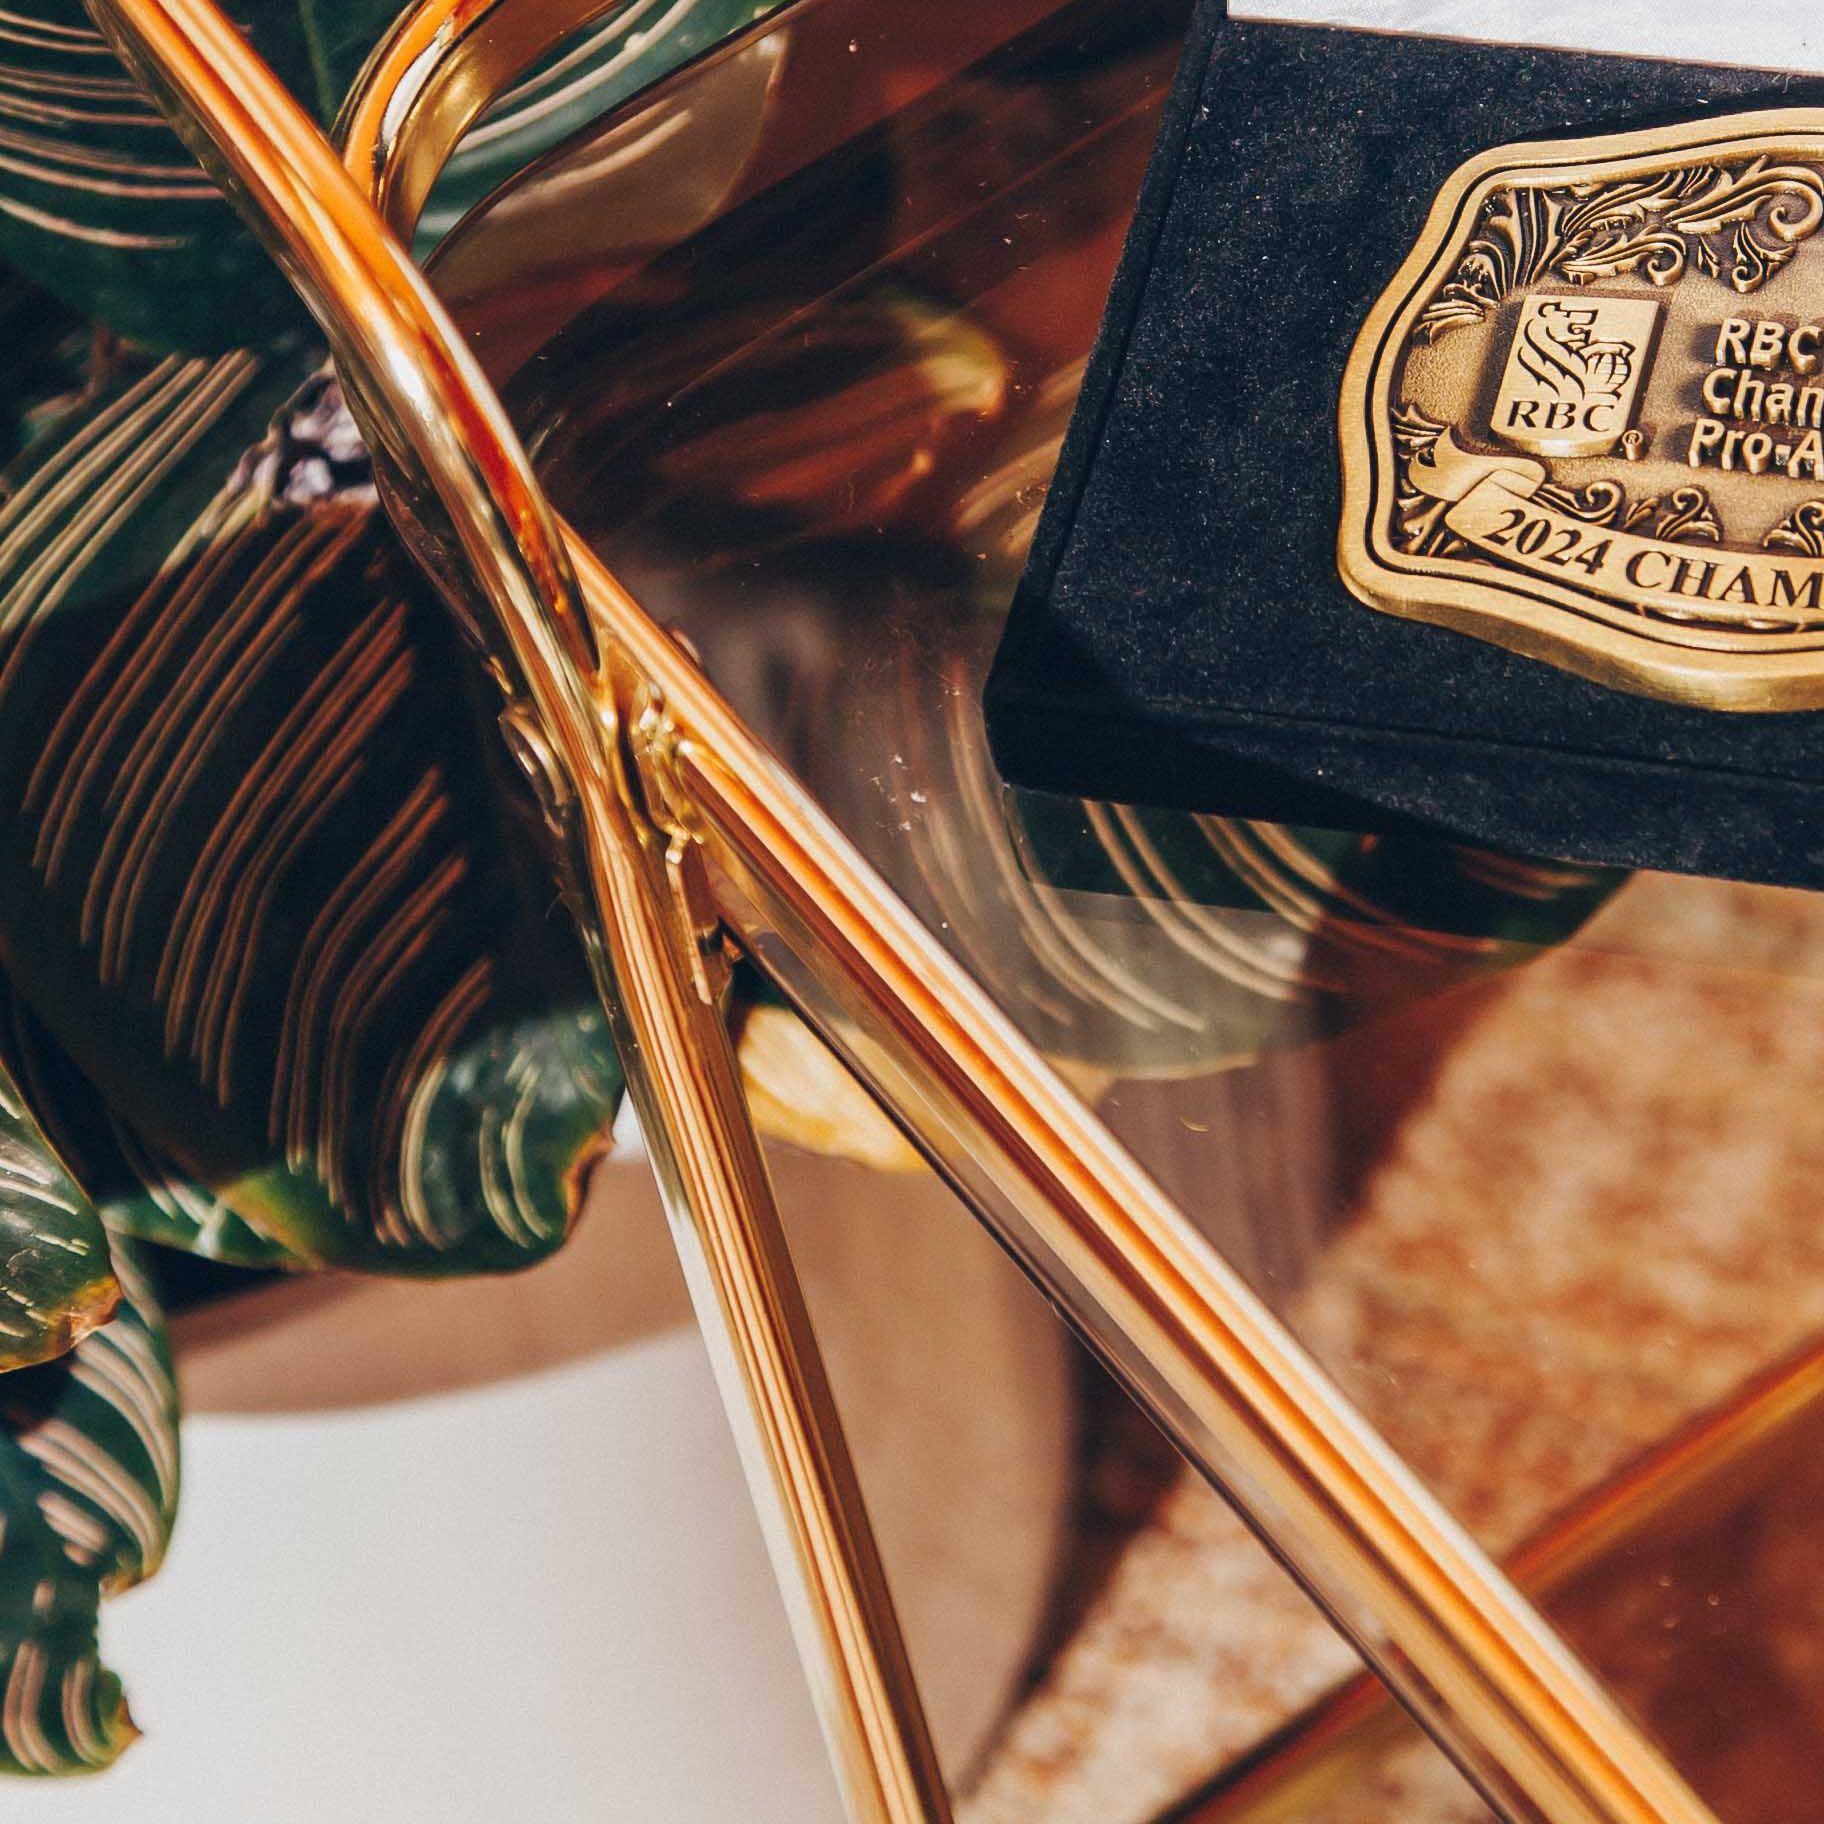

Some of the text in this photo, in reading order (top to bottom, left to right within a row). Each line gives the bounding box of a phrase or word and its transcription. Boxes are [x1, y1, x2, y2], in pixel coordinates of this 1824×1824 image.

[1715, 318, 1824, 374] RBC
[1506, 399, 1616, 433] RBC
[1482, 507, 1615, 576] 2024
